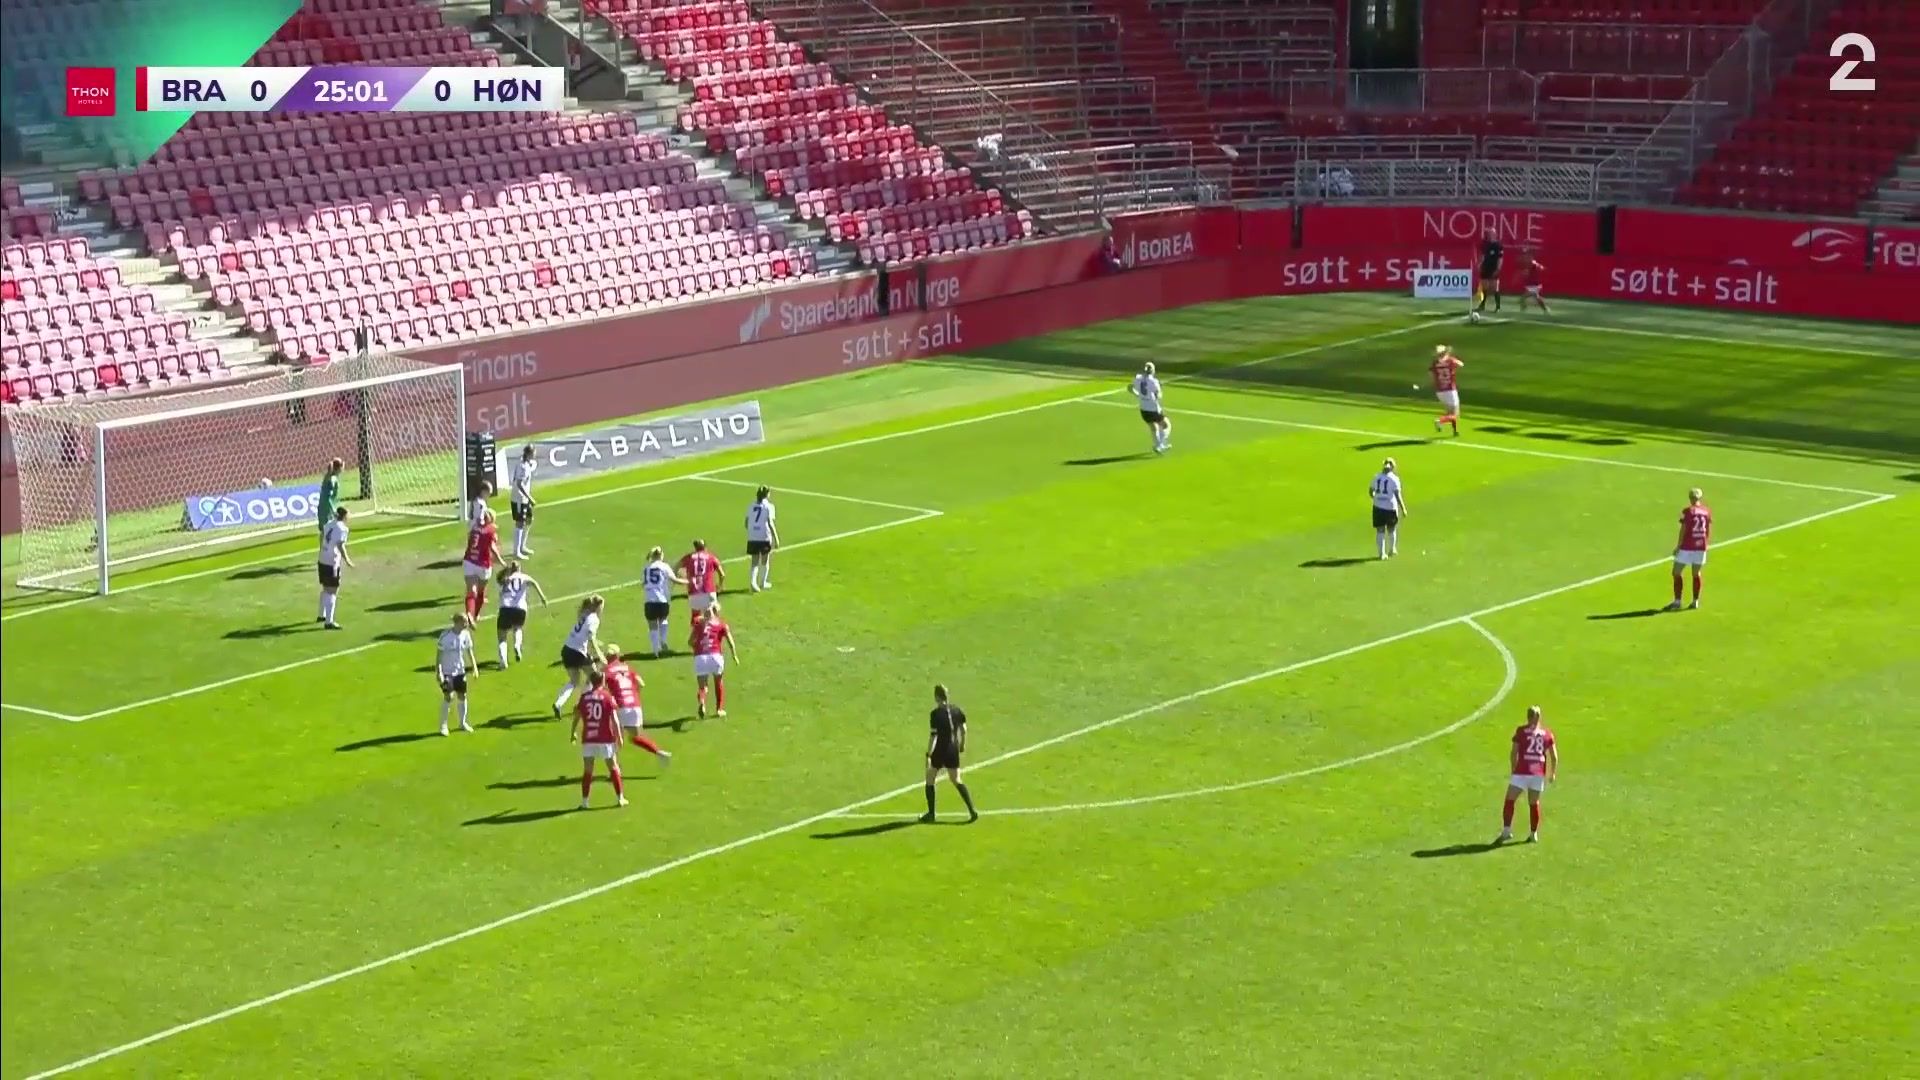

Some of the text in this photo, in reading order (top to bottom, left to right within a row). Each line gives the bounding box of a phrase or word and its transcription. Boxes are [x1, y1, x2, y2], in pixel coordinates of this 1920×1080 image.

[1139, 231, 1194, 260] BOREA
[1873, 232, 1920, 266] Fre
[1283, 256, 1349, 287] søtt
[1426, 274, 1469, 287] 07000
[1610, 266, 1679, 296] søtt
[1714, 271, 1778, 304] salt
[905, 276, 960, 308] Nrge
[842, 327, 893, 365] søtt
[918, 312, 962, 352] salt
[458, 350, 537, 385] Finans
[477, 391, 533, 431] salt
[549, 413, 751, 467] CABAL.NO
[1376, 478, 1388, 494] 11
[247, 491, 321, 521] OBOS
[753, 506, 762, 523] 7
[645, 567, 660, 584] 15
[586, 702, 603, 720] 30
[1526, 735, 1544, 754] 28
